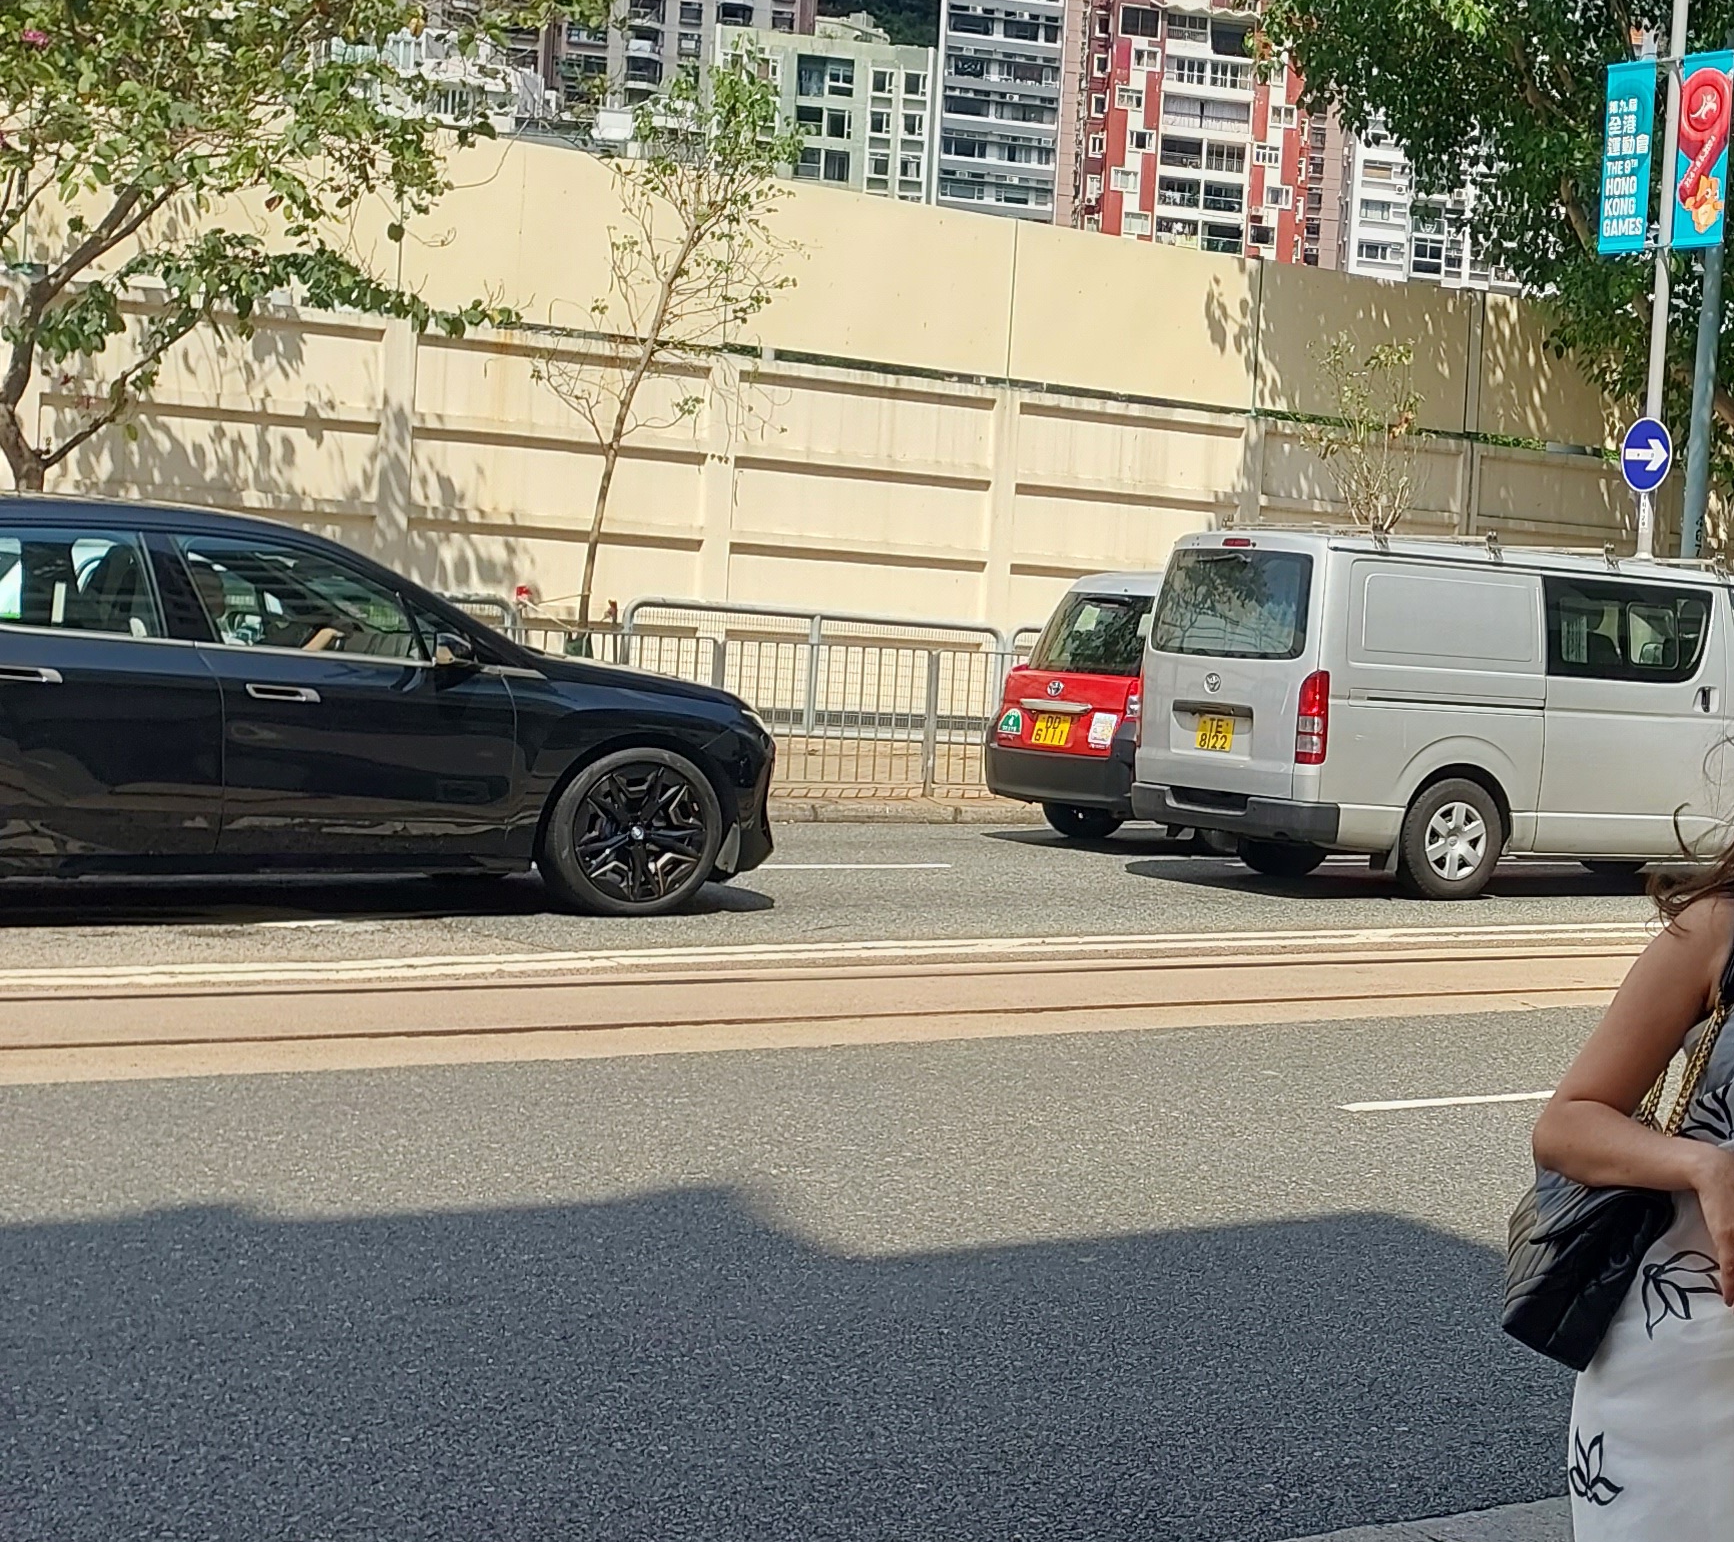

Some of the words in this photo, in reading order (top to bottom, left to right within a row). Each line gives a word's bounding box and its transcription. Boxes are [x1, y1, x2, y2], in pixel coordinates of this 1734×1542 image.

[1608, 98, 1638, 115] 第九屆
[1608, 115, 1637, 136] 全港
[1606, 134, 1650, 157] 運動會
[1606, 161, 1624, 176] THE
[1605, 175, 1638, 197] HONG
[1603, 197, 1637, 218] KONG
[1602, 217, 1644, 238] GAMES
[1209, 717, 1225, 734] TE
[1035, 727, 1064, 744] 6111
[1198, 732, 1228, 750] 8122
